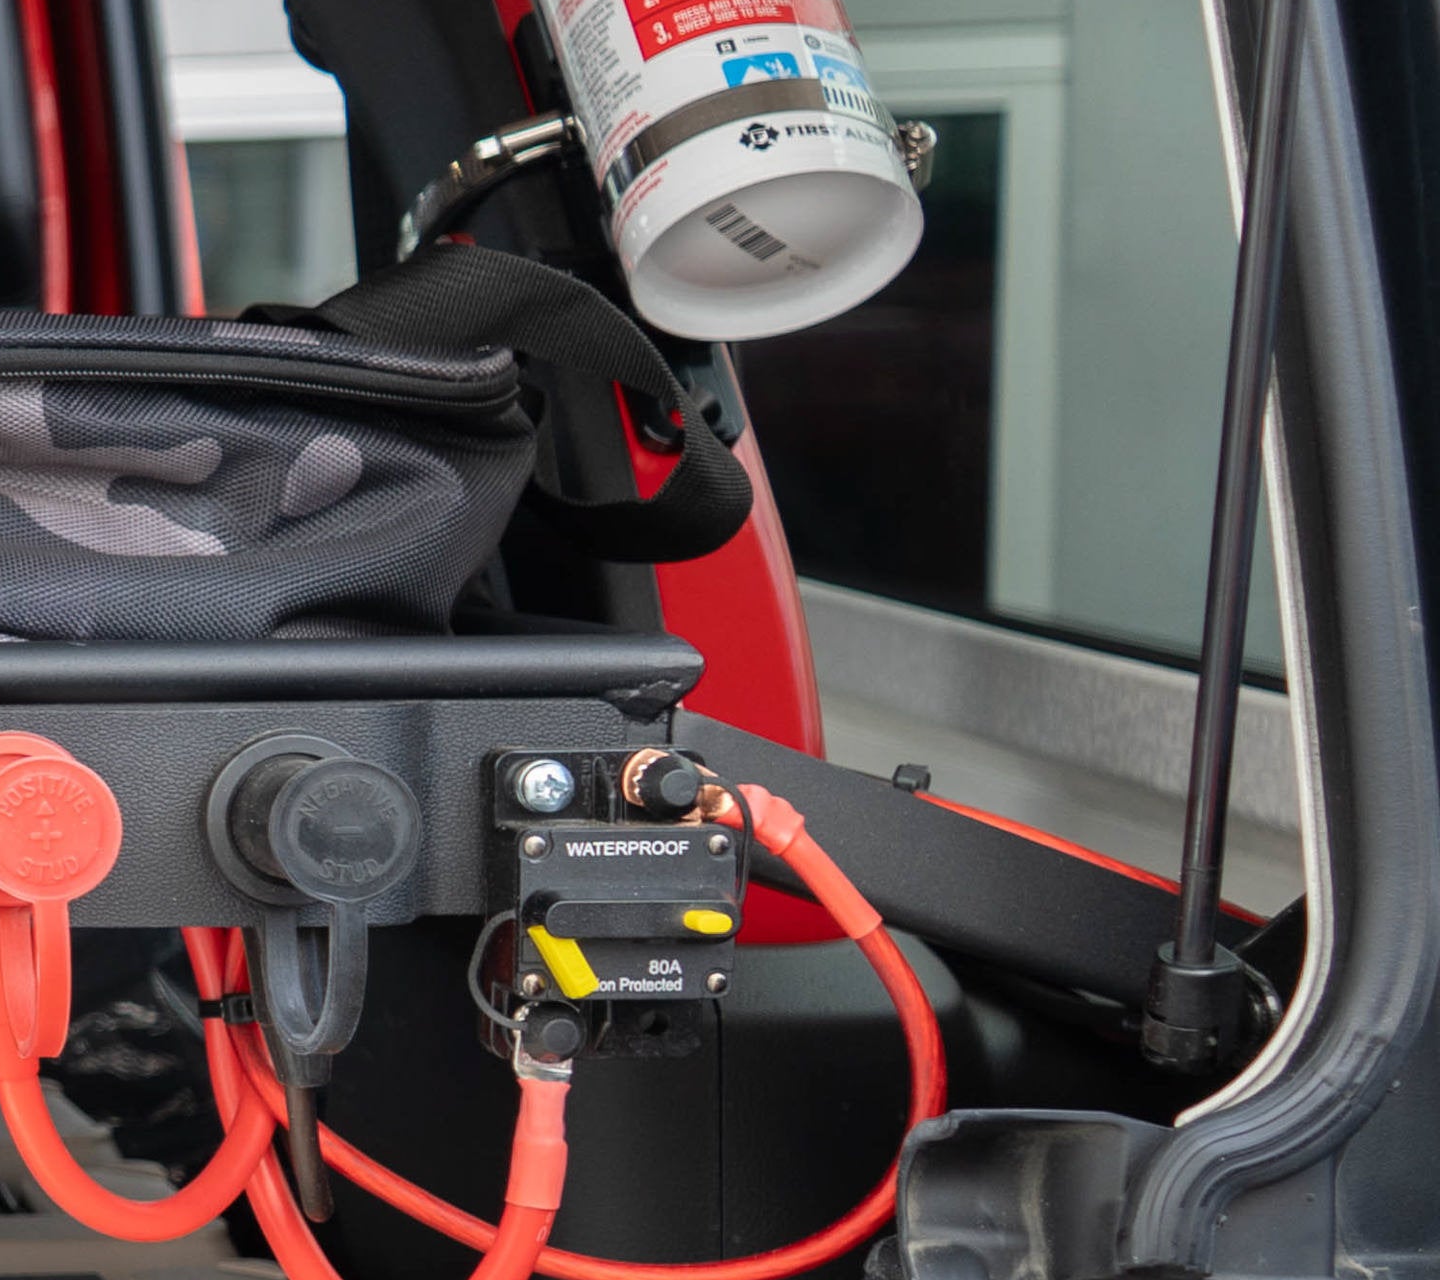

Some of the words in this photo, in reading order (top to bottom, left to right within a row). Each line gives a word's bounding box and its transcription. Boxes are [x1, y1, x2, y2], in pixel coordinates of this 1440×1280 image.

[673, 3, 708, 23] PRESS
[677, 14, 712, 35] SWEEP
[714, 9, 739, 23] SIDE
[740, 7, 754, 18] TO
[296, 778, 402, 820] NEGATIVE
[565, 840, 690, 857] WATERPROOF
[16, 854, 80, 882] STUD
[317, 857, 379, 883] STUD
[648, 959, 682, 975] 80A
[619, 977, 683, 993] Protected
